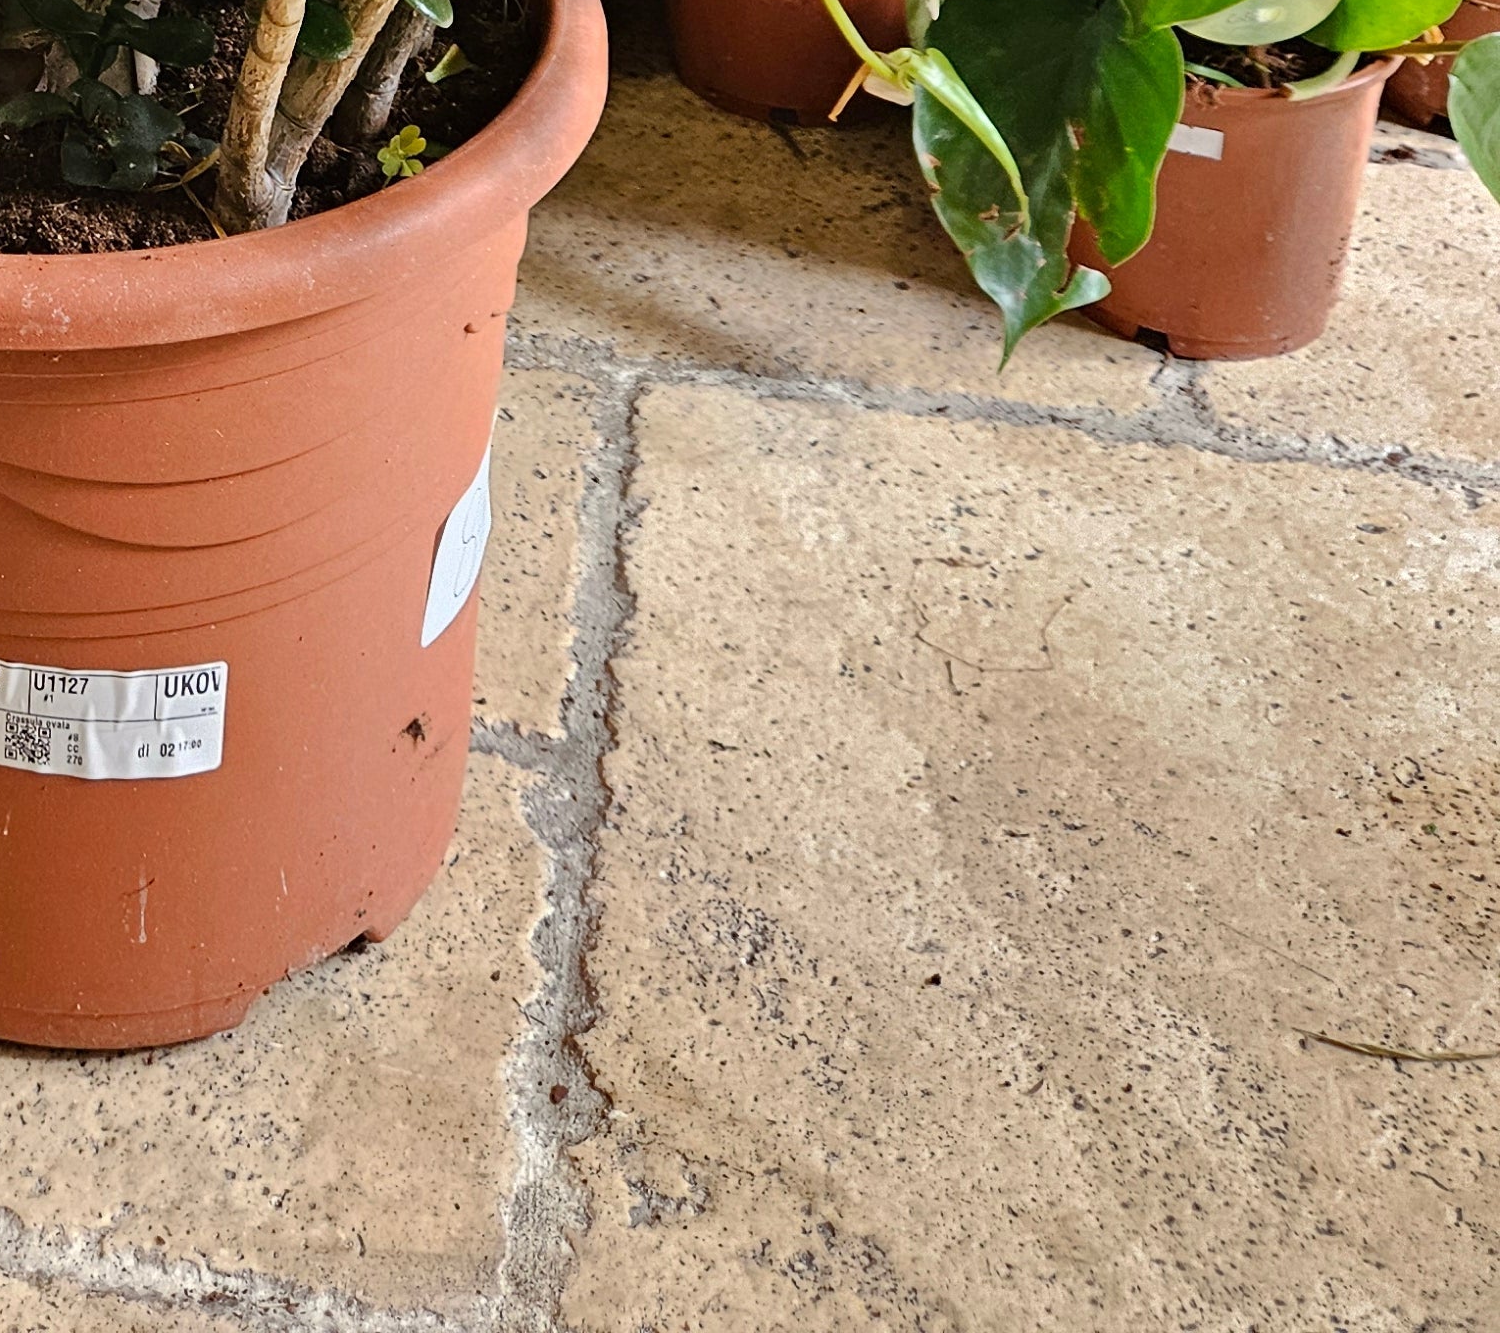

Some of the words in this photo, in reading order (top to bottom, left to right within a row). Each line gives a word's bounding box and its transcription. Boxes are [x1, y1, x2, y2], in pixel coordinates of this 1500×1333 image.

[33, 672, 89, 695] U1127
[67, 744, 79, 754] CC
[159, 743, 175, 758] 02
